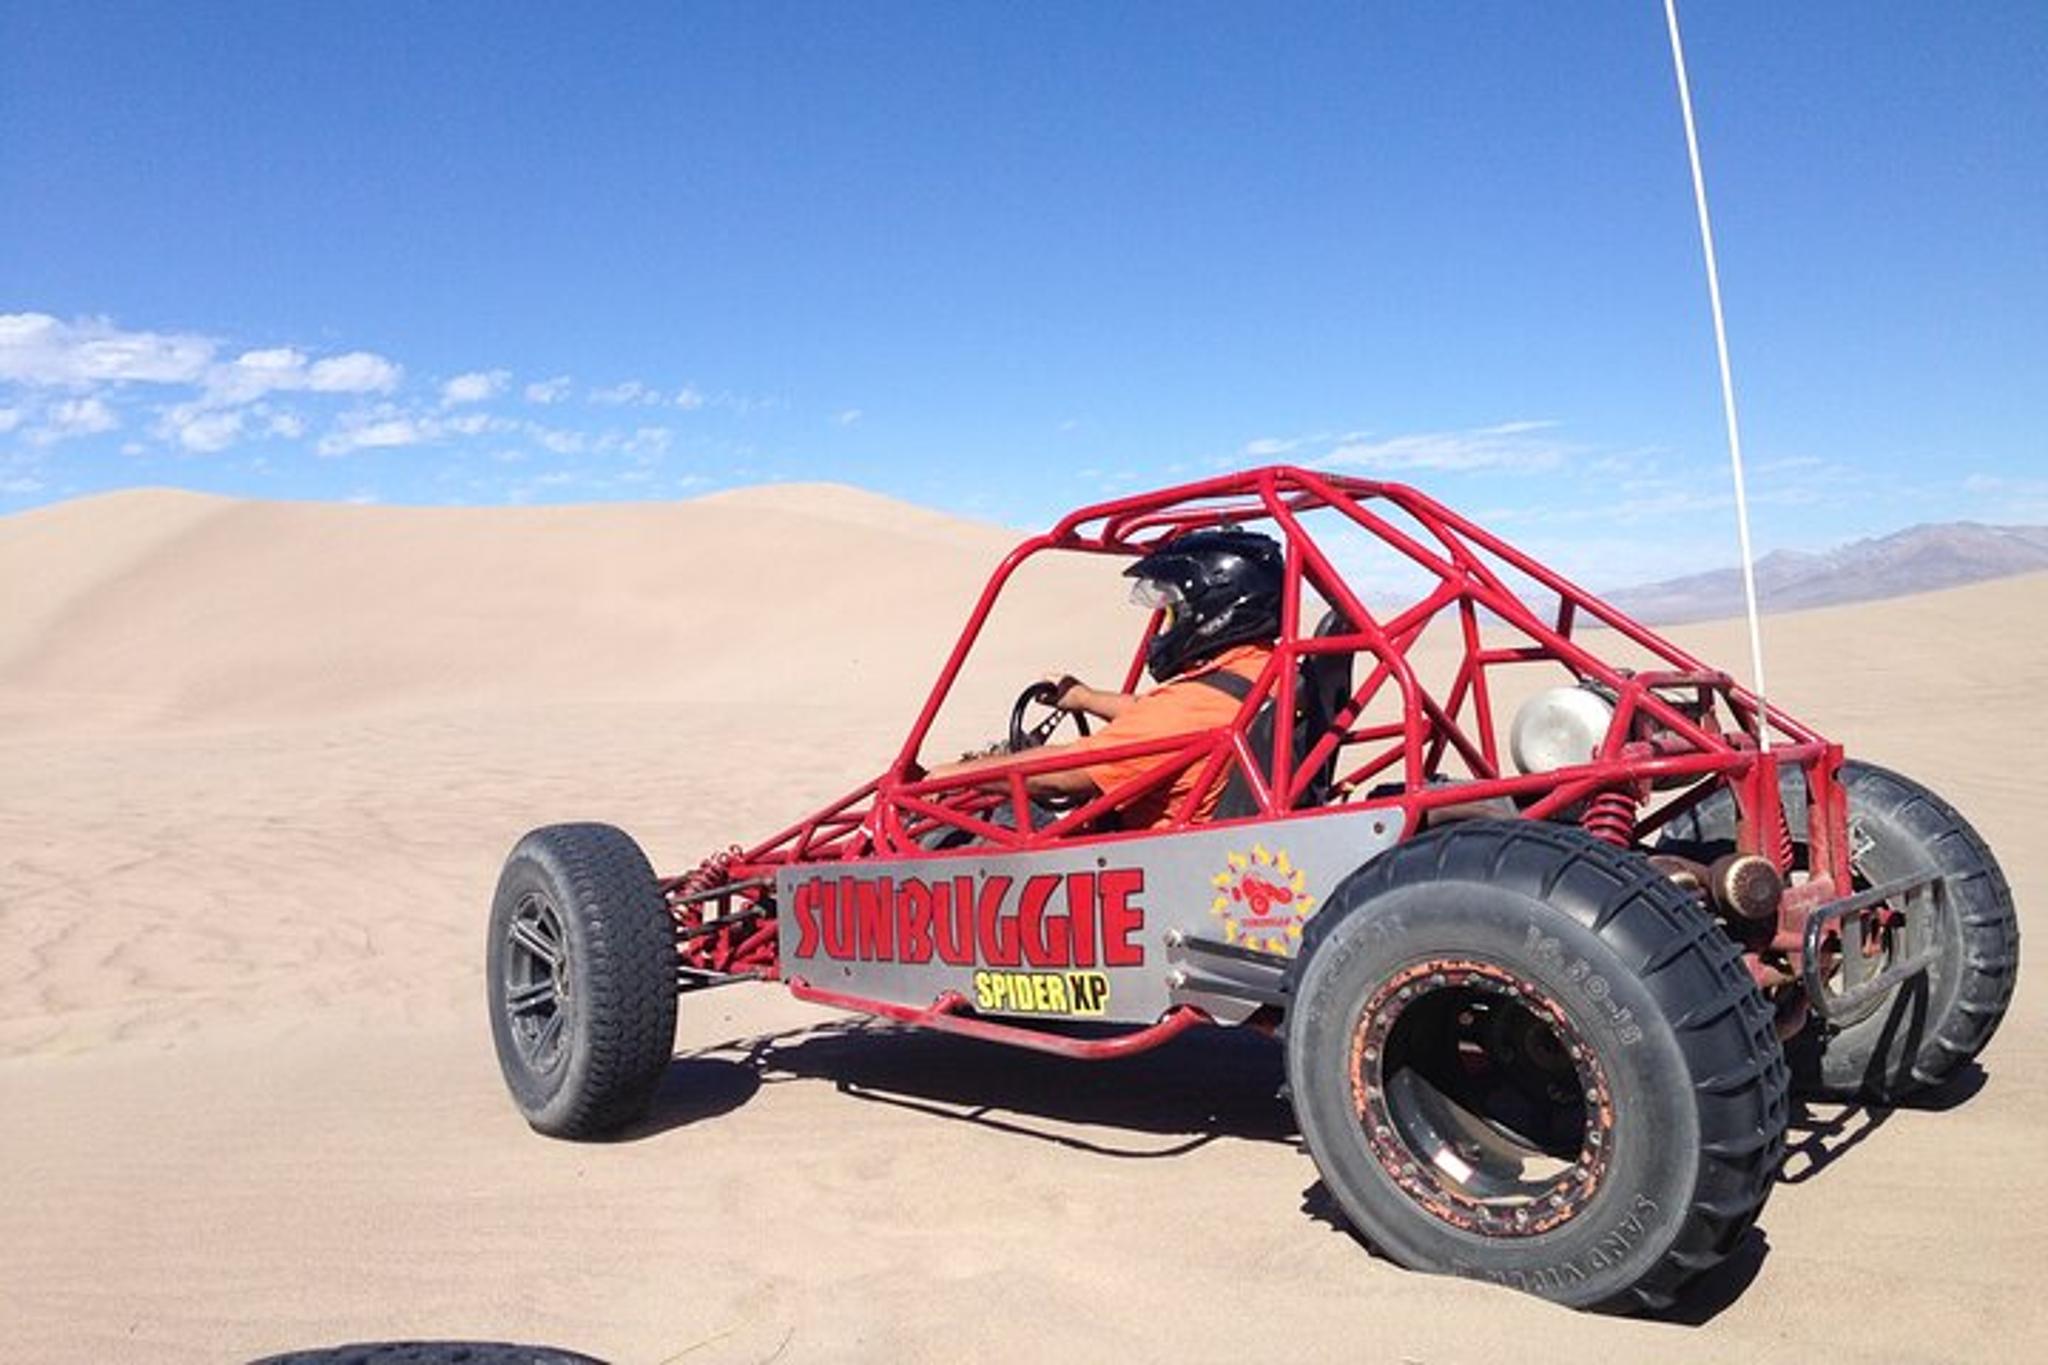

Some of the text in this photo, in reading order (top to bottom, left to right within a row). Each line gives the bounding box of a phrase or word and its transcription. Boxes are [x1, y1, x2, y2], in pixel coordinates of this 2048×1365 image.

[793, 868, 1144, 967] SUNBUGGIE
[974, 969, 1107, 1011] SPIDER XP
